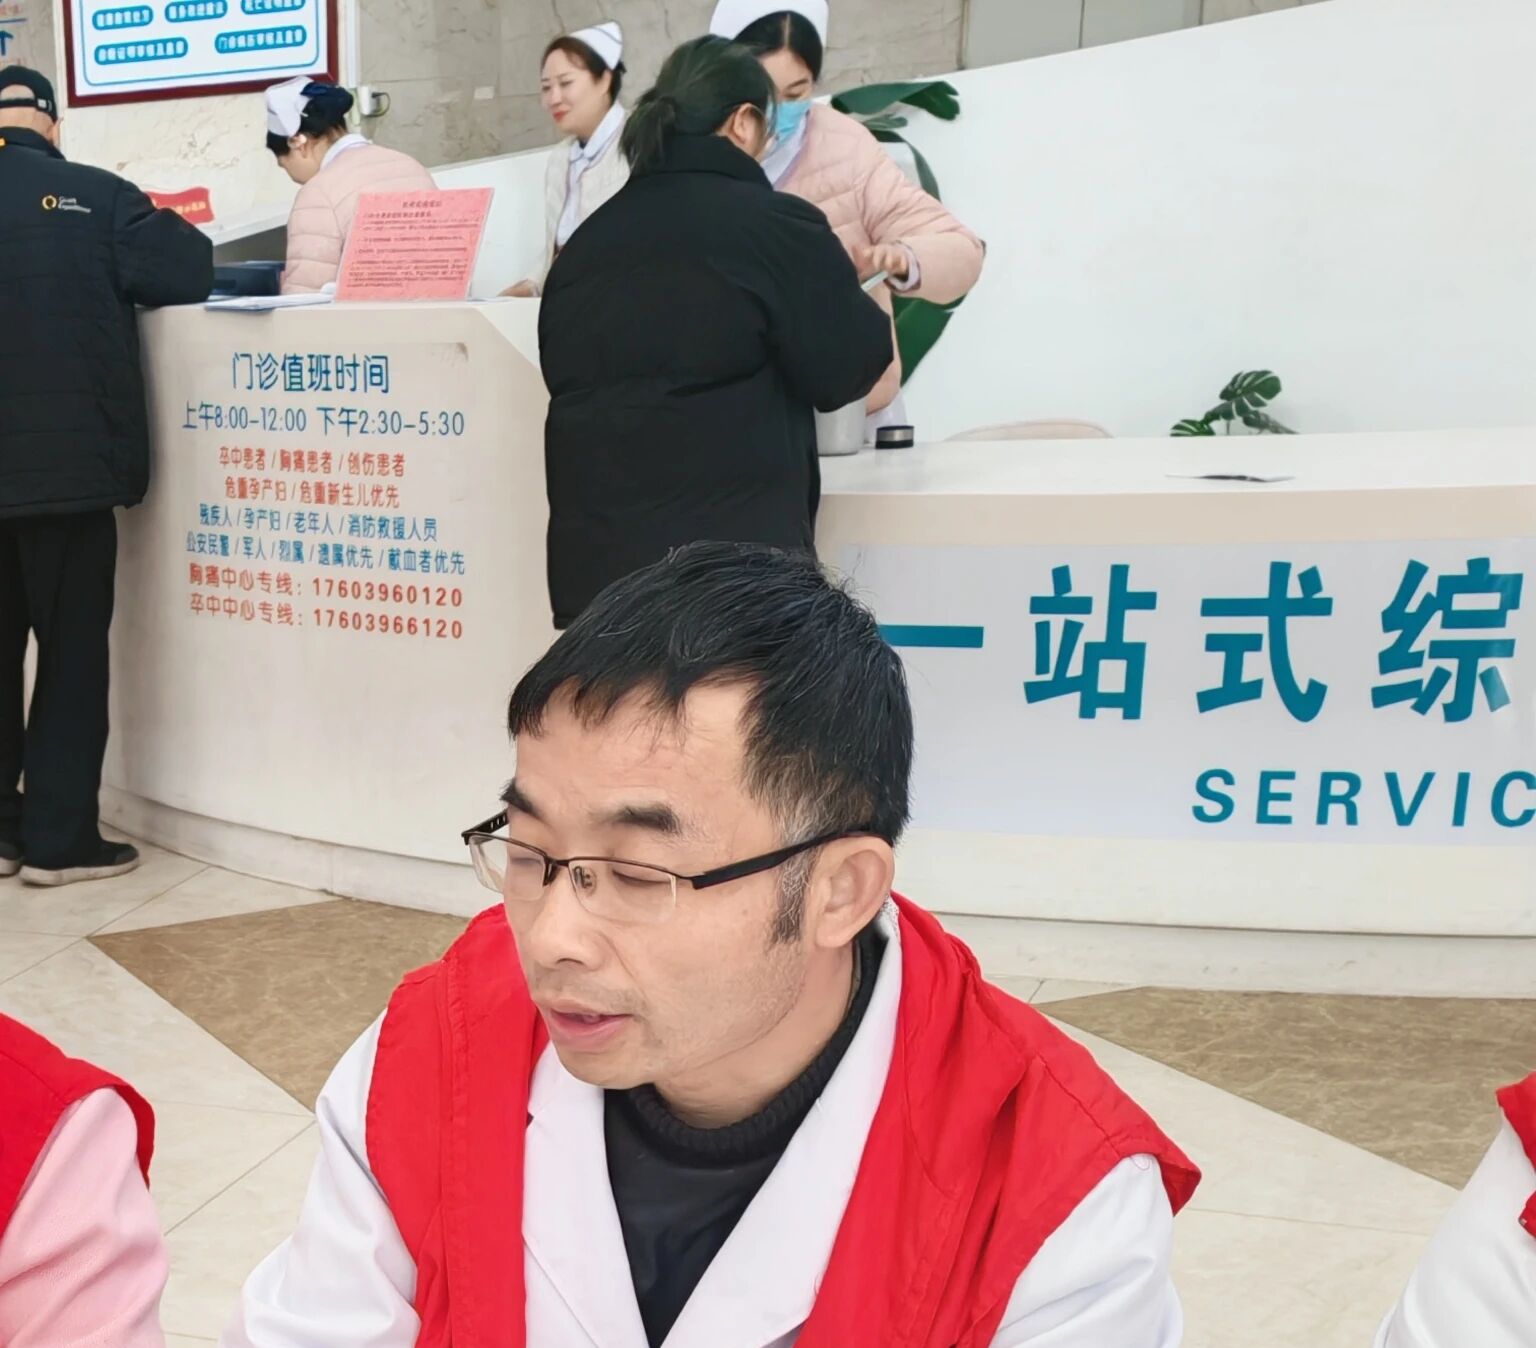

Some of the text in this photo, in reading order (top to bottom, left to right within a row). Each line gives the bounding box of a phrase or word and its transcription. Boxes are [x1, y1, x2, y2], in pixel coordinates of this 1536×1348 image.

[232, 352, 390, 394] 门诊值班时间
[182, 401, 465, 437] 上午8:00-12:00 下午2:30-5:30
